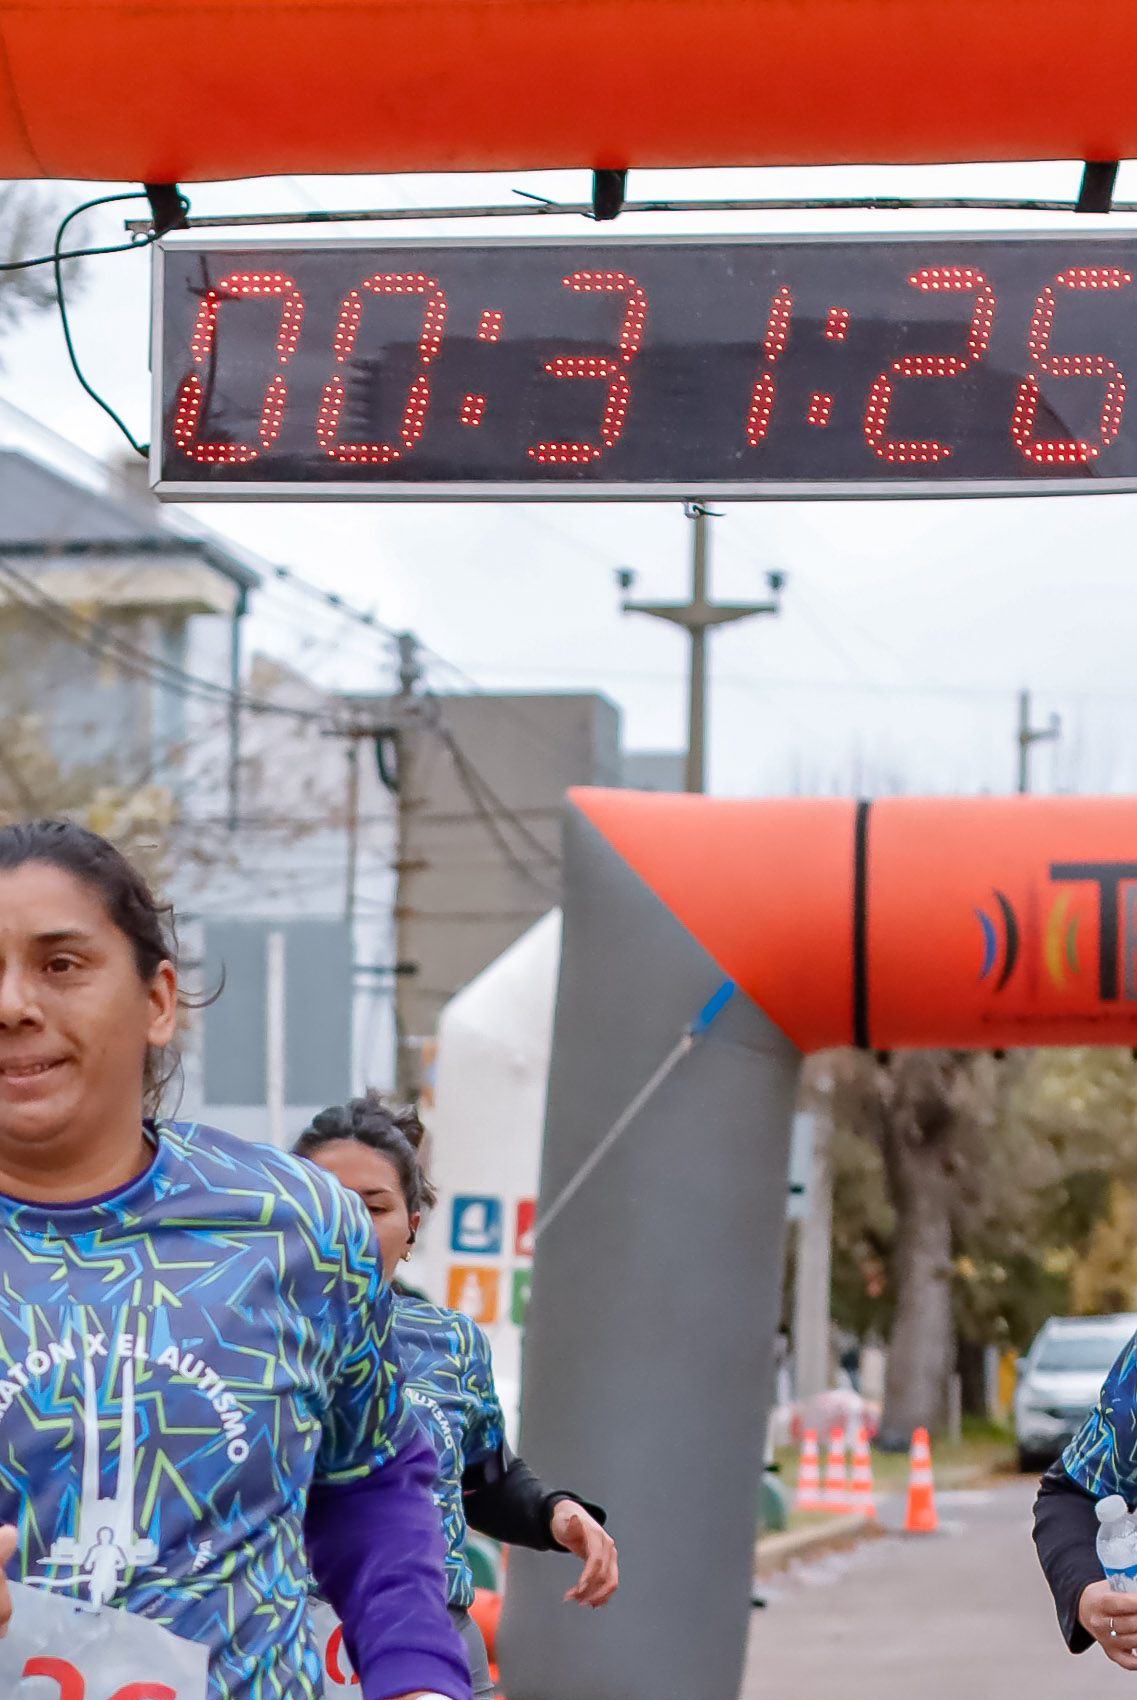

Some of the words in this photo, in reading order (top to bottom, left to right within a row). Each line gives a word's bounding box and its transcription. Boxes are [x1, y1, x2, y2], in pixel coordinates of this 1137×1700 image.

[87, 1332, 109, 1358] X
[117, 1332, 150, 1359] EL
[157, 1345, 250, 1464] AUTISMO
